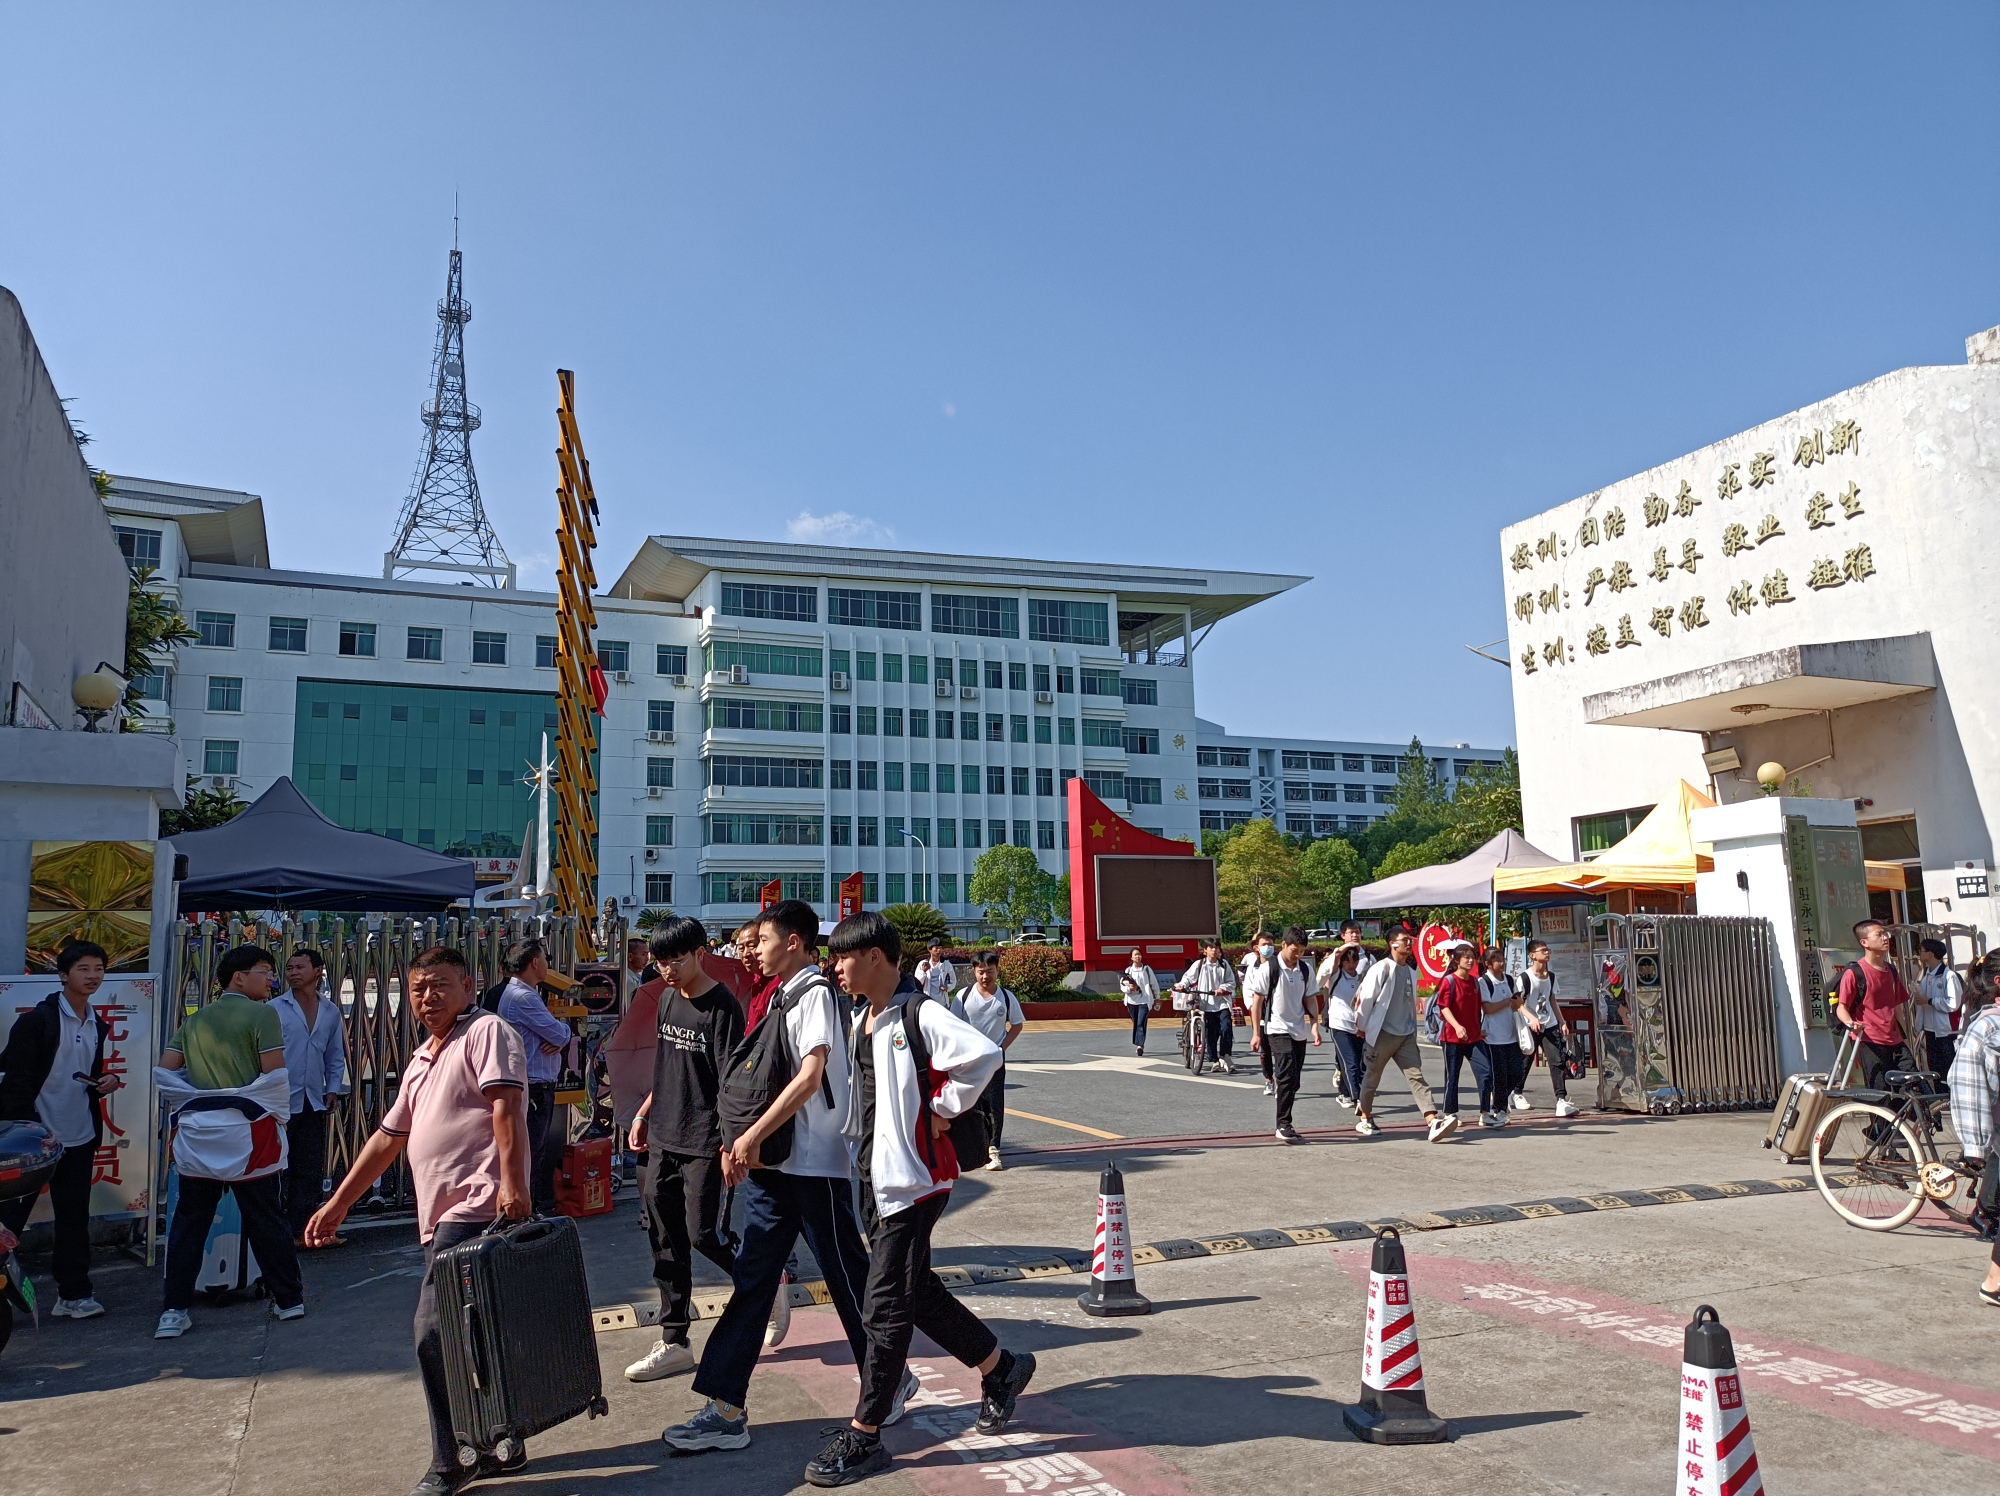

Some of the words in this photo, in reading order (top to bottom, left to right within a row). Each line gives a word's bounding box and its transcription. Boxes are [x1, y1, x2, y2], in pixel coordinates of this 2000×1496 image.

[1510, 532, 1568, 574] 校训：
[1580, 506, 1626, 548] 团结
[1643, 479, 1702, 528] 勤奋
[1717, 452, 1776, 500] 求实
[1792, 418, 1861, 468] 创新
[1514, 583, 1570, 624] 师训：
[1648, 538, 1703, 582] 善导
[1721, 514, 1786, 557] 敬业
[1805, 480, 1865, 530] 爱生
[1521, 635, 1575, 675] 生训：
[1586, 613, 1642, 657] 德美
[1648, 596, 1710, 638] 智优
[1726, 568, 1796, 617] 体健
[1806, 542, 1876, 591] 趣雅
[1959, 884, 1986, 894] 报警点
[1542, 920, 1568, 931] 2525901
[1110, 1222, 1125, 1275] 禁止停车
[1387, 1282, 1405, 1292] 航母
[1388, 1292, 1406, 1302] 品质
[1365, 1306, 1376, 1378] 禁止停车
[1718, 1379, 1737, 1391] 航母
[1721, 1392, 1739, 1405] 品质
